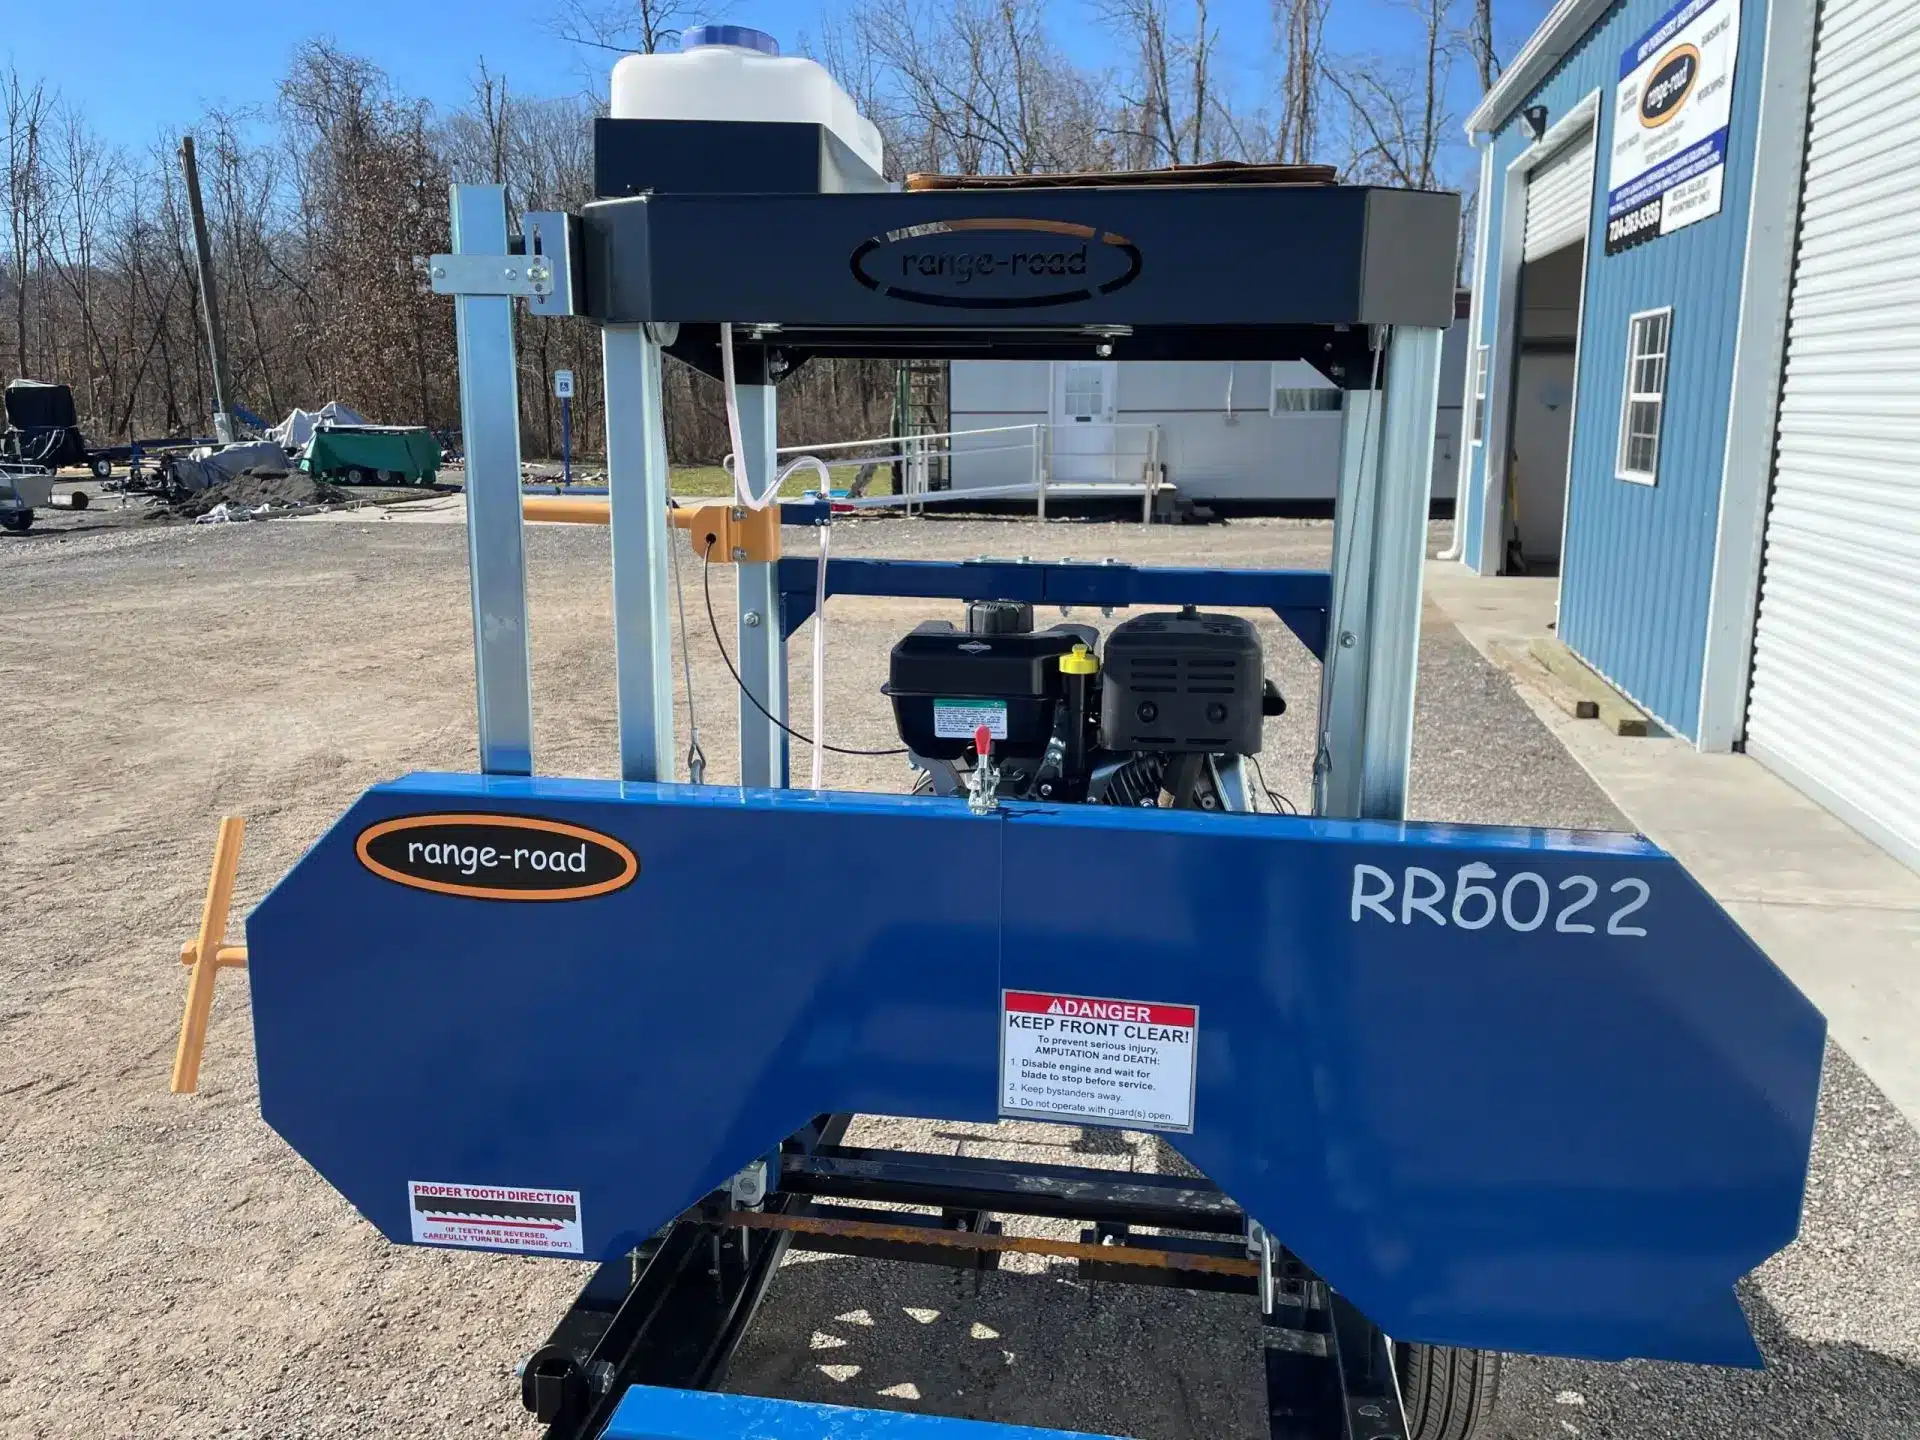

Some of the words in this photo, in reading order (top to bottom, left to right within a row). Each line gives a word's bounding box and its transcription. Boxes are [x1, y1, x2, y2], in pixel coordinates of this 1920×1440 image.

[901, 242, 1088, 284] range-road
[408, 842, 586, 875] range-road
[1064, 1000, 1151, 1023] DANGER
[1009, 1015, 1055, 1031] KEEP
[1060, 1019, 1119, 1037] FRONT
[1124, 1025, 1189, 1044] CLEAR!
[1038, 1035, 1050, 1043] To
[1052, 1038, 1088, 1047] prevent
[1090, 1041, 1126, 1051] serious
[1035, 1046, 1100, 1059] AMPUTATION
[1102, 1053, 1120, 1061] and
[1123, 1054, 1160, 1065] DEATH:
[1022, 1059, 1057, 1069] Disable
[1060, 1064, 1092, 1073] engine
[1094, 1067, 1112, 1075] and
[1115, 1069, 1134, 1077] wait
[1137, 1070, 1151, 1078] for
[1021, 1070, 1047, 1080] blade
[1050, 1073, 1059, 1081] to
[1062, 1075, 1083, 1085] stop
[1085, 1077, 1116, 1087] before
[1118, 1081, 1156, 1091] service.
[1021, 1084, 1044, 1095] Keep
[1046, 1086, 1095, 1099] bystanders
[1020, 1098, 1033, 1107] Do
[1036, 1100, 1050, 1108] not
[1052, 1102, 1086, 1112] operate
[1088, 1104, 1106, 1114] with
[1108, 1107, 1146, 1119] guard(s)
[1148, 1112, 1174, 1121] open.
[414, 1185, 462, 1197] PROPER
[464, 1188, 505, 1200] TOOTH
[507, 1191, 575, 1204] DIRECTION
[423, 1232, 468, 1241] CAREFULLY
[470, 1235, 493, 1243] TURN
[494, 1237, 520, 1245] BLADE
[522, 1239, 549, 1247] INSIDE
[458, 1227, 483, 1235] TEETH
